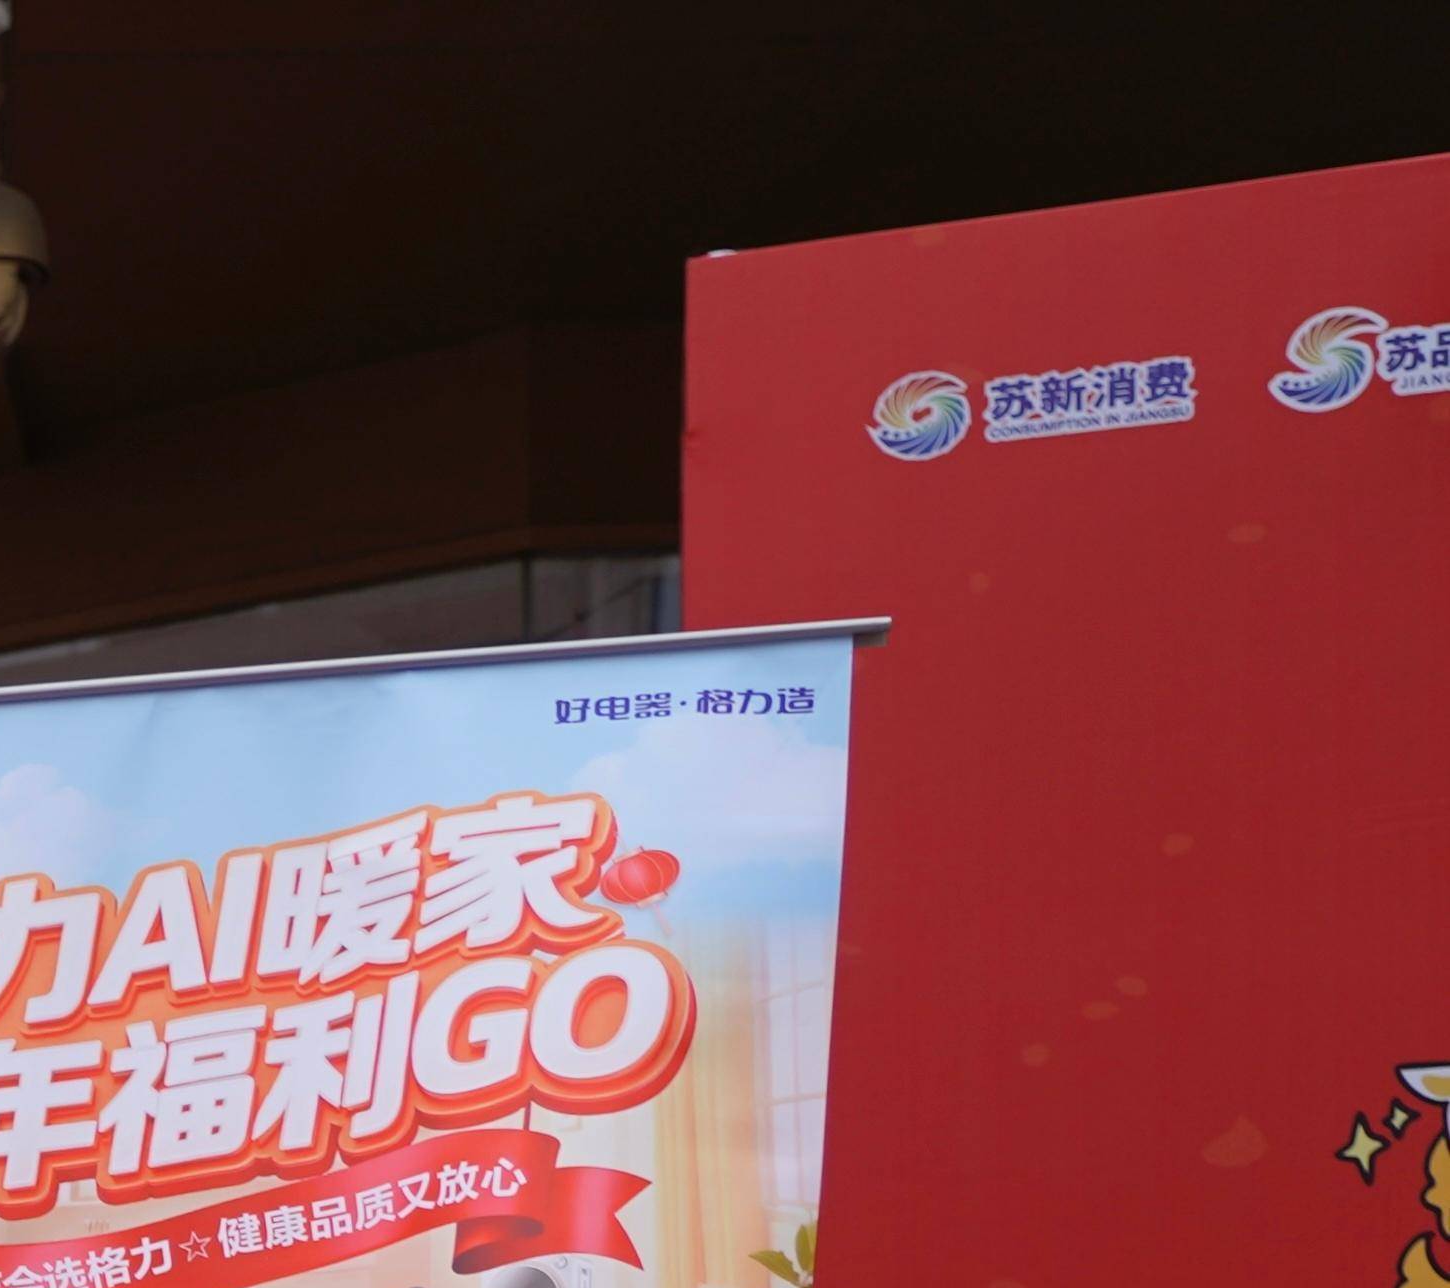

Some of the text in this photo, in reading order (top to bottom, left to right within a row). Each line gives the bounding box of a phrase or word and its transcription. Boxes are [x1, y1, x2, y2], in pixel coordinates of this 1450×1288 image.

[991, 361, 1190, 421] 苏新消费
[217, 1161, 528, 1262] 健康品质又放心
